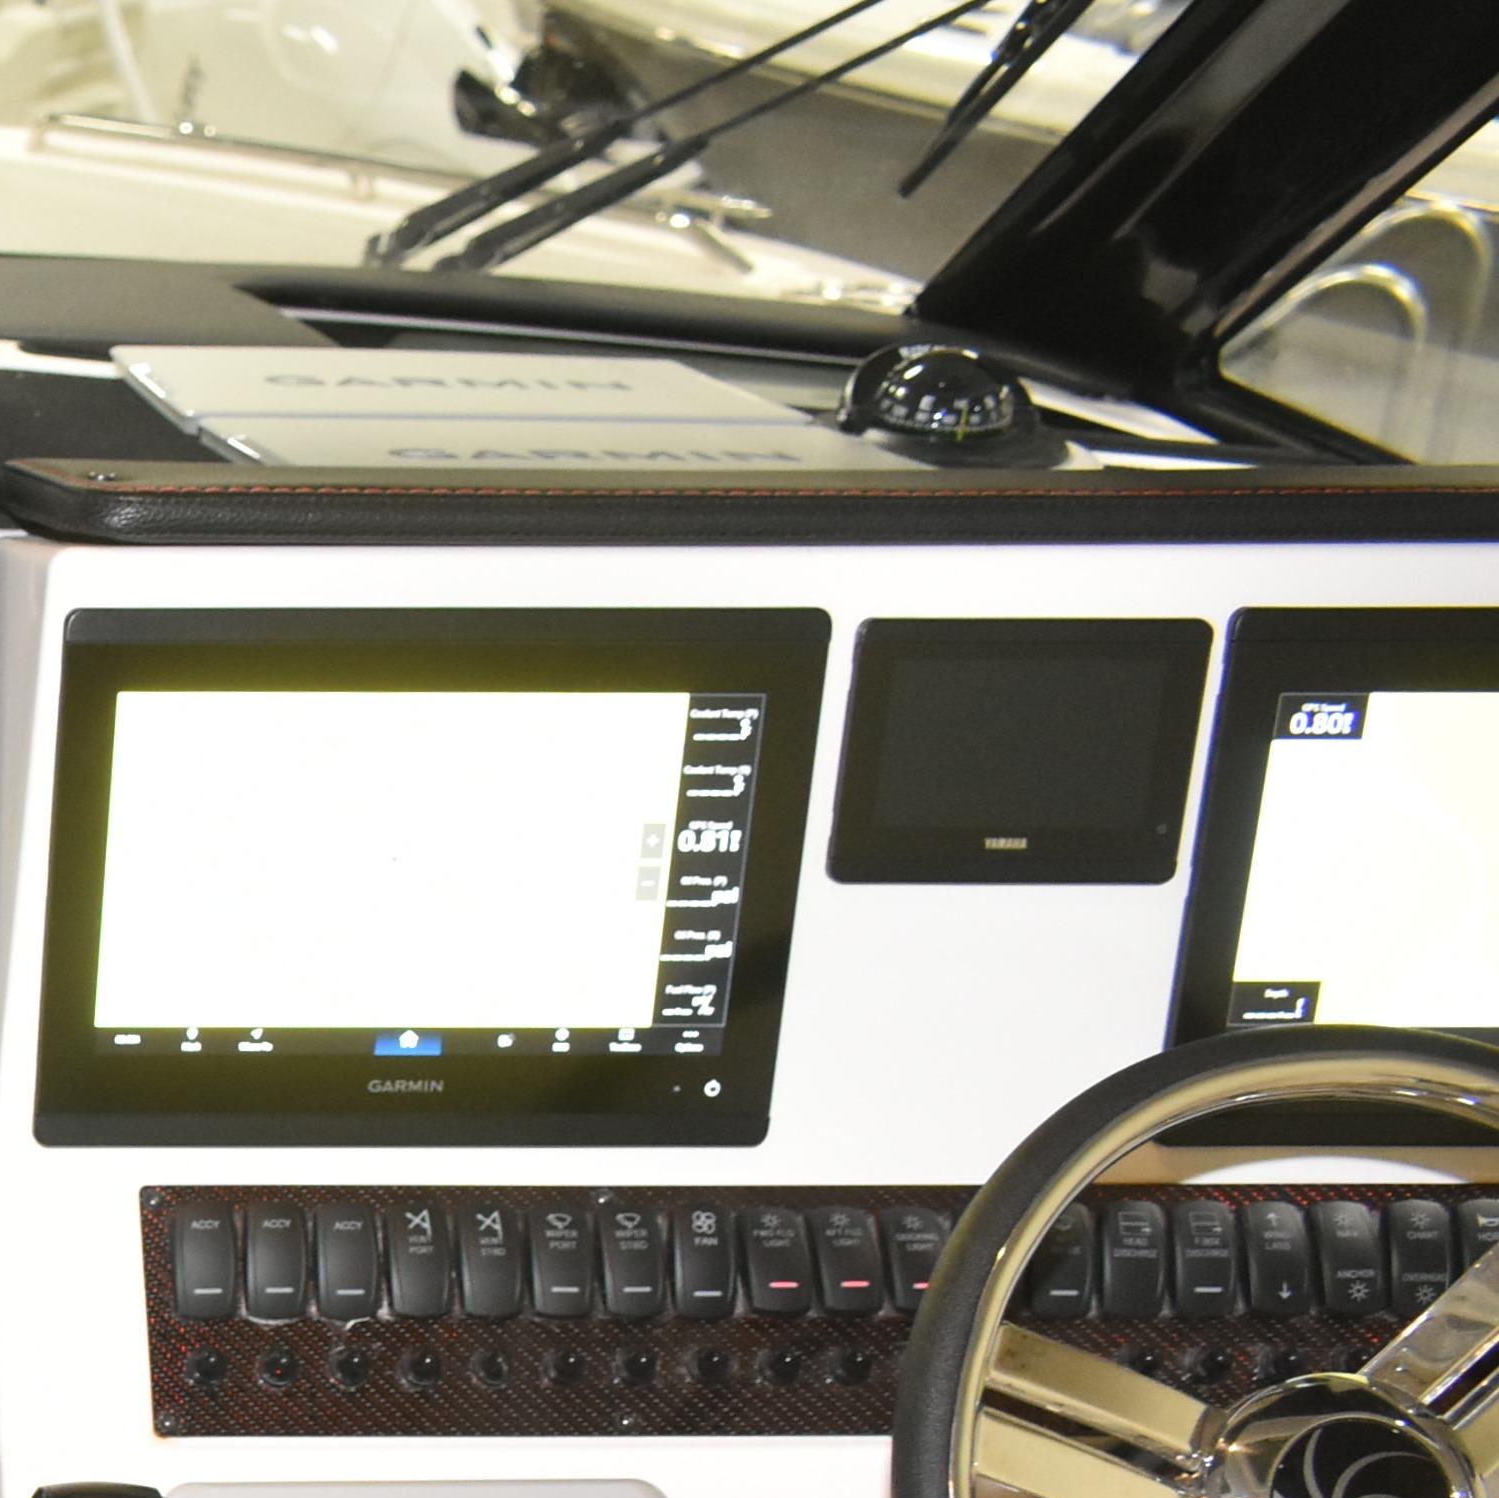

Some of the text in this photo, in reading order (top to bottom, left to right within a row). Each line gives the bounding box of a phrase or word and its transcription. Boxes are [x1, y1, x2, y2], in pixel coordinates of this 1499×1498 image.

[264, 373, 632, 391] GARMIN
[386, 446, 803, 462] GARMIN
[367, 1079, 444, 1093] GARMIN
[190, 1219, 221, 1229] ACCY
[262, 1218, 292, 1229] ACCY
[333, 1220, 363, 1231] ACCY
[545, 1229, 579, 1239] WIPER
[549, 1240, 577, 1249] PORT
[694, 1236, 718, 1246] FAN
[1336, 1268, 1376, 1279] ANCHOR
